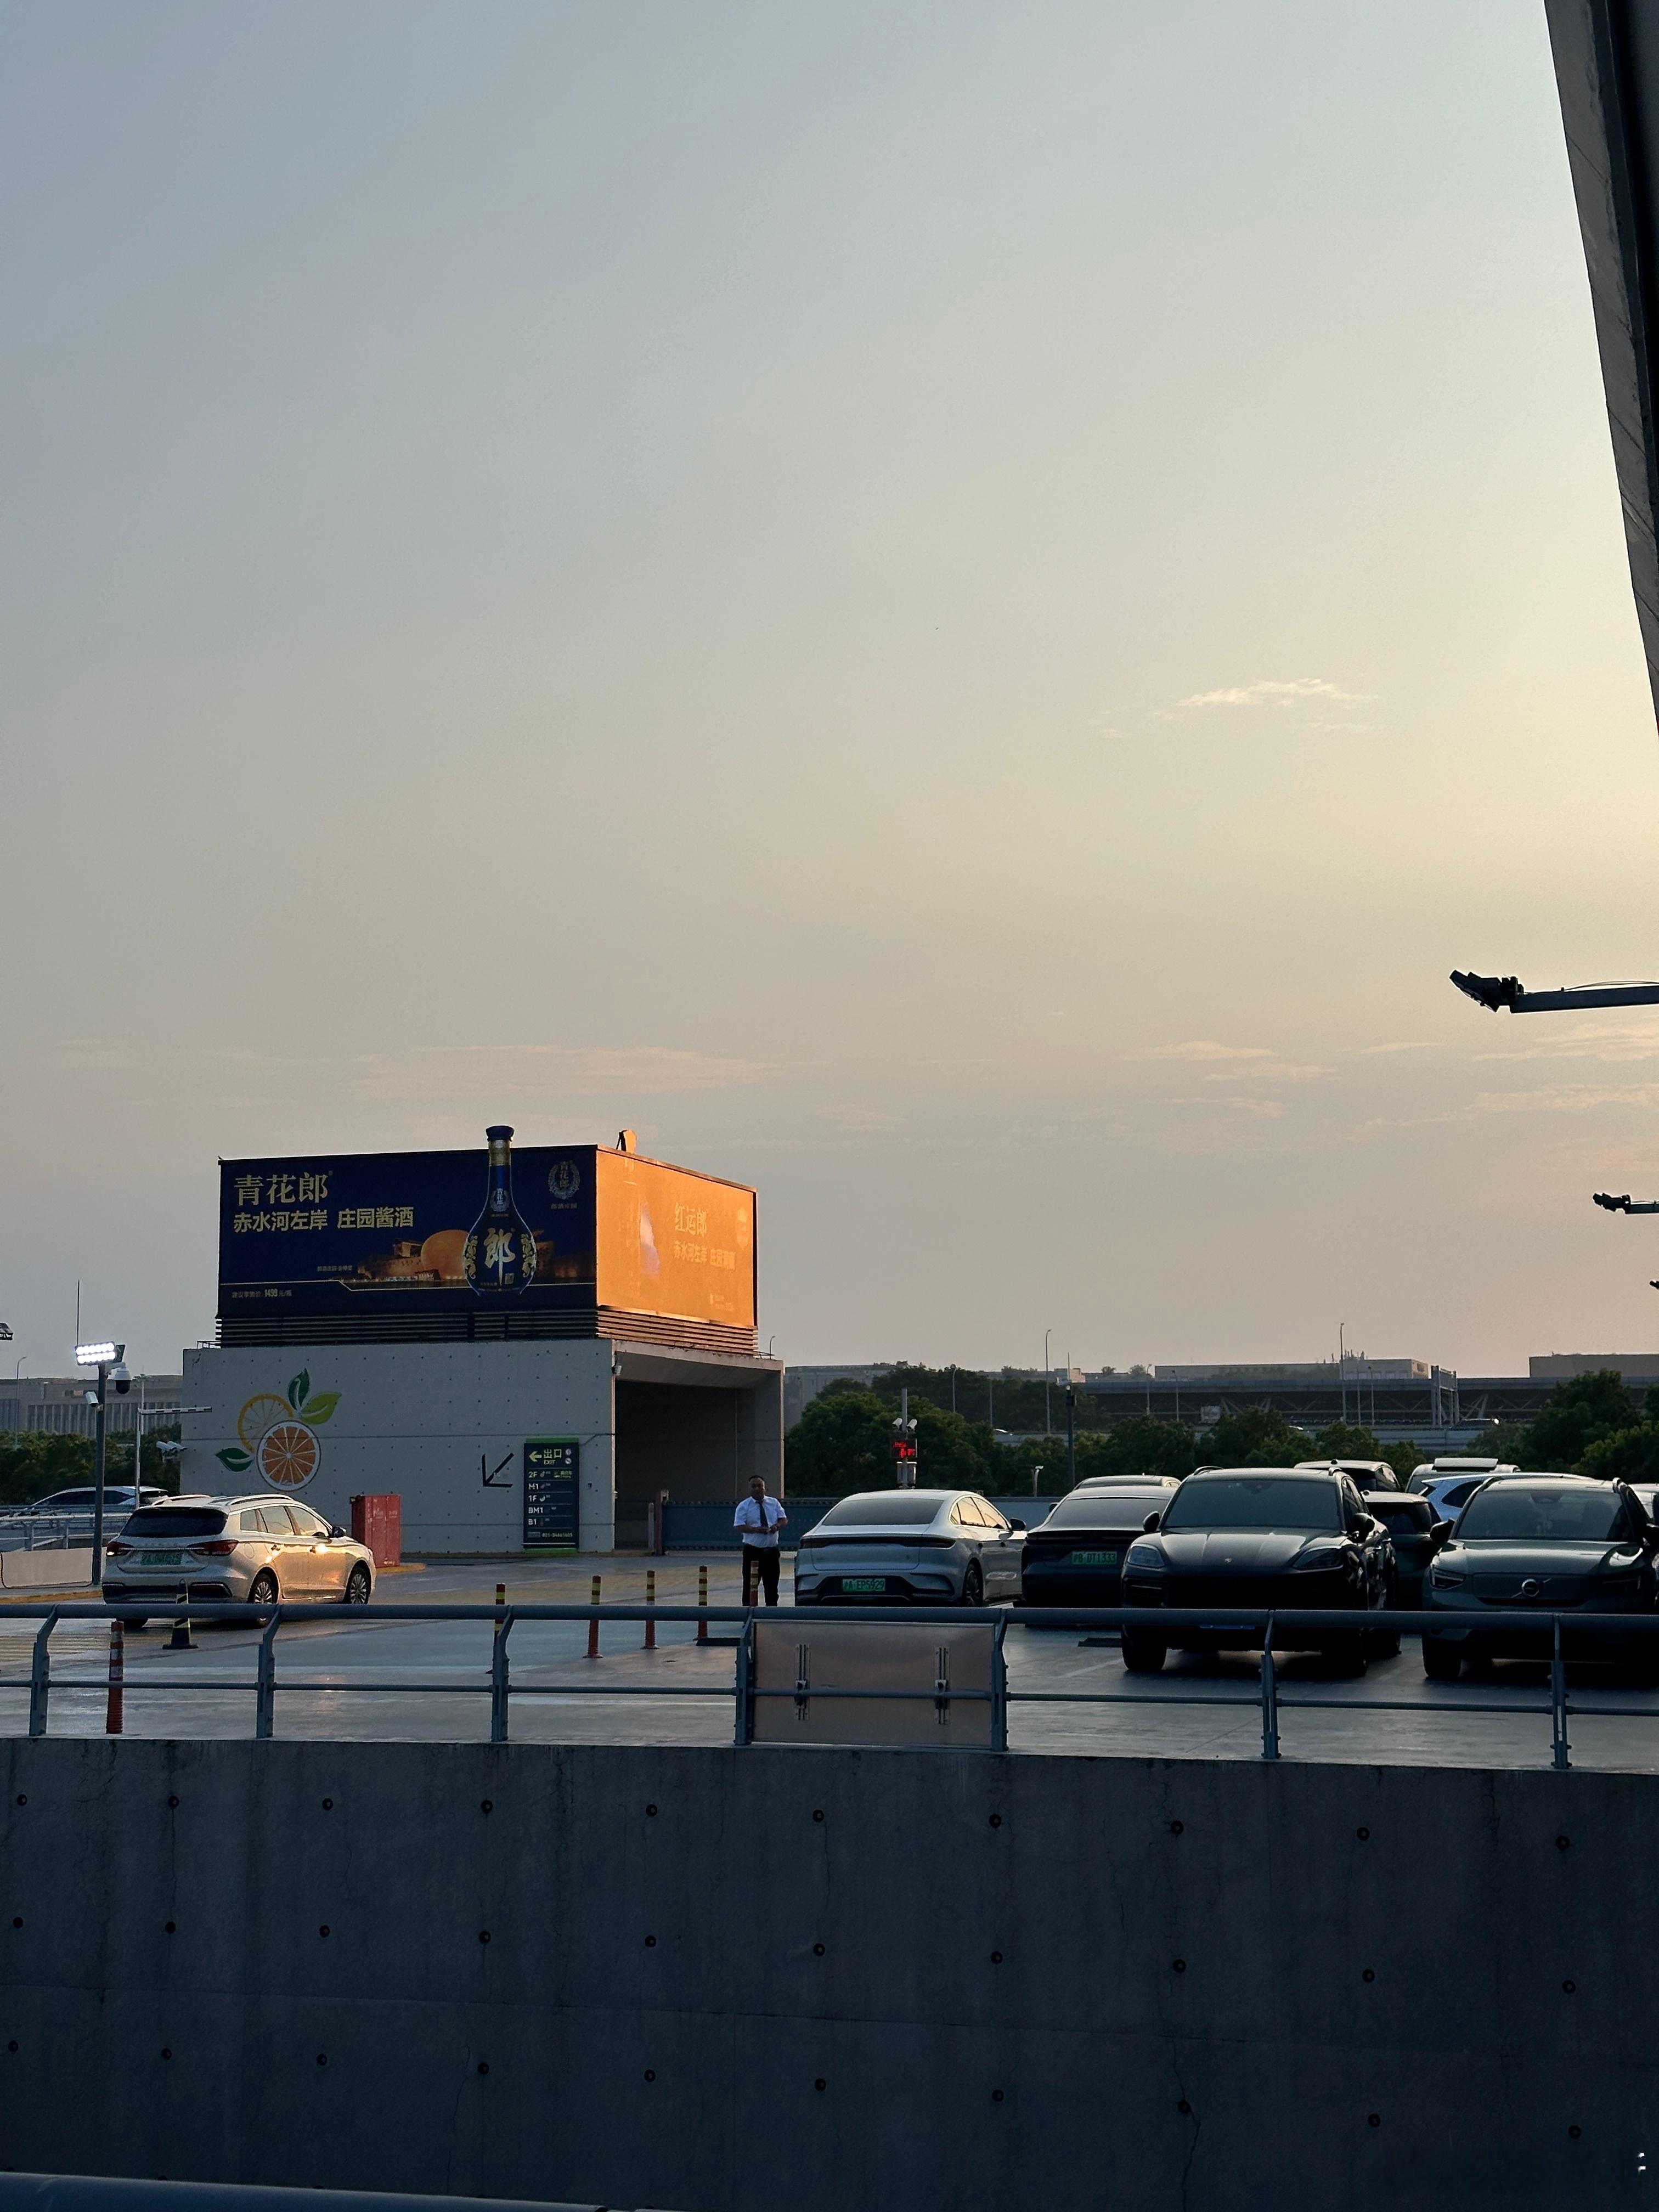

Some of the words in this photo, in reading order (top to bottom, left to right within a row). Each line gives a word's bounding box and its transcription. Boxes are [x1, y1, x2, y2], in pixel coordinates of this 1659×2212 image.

[234, 1172, 329, 1206] 青花郎
[234, 1209, 328, 1233] 赤水河左岸
[337, 1206, 414, 1229] 庄园酱酒
[674, 1203, 707, 1238] 红运郎
[544, 1448, 562, 1459] 出口
